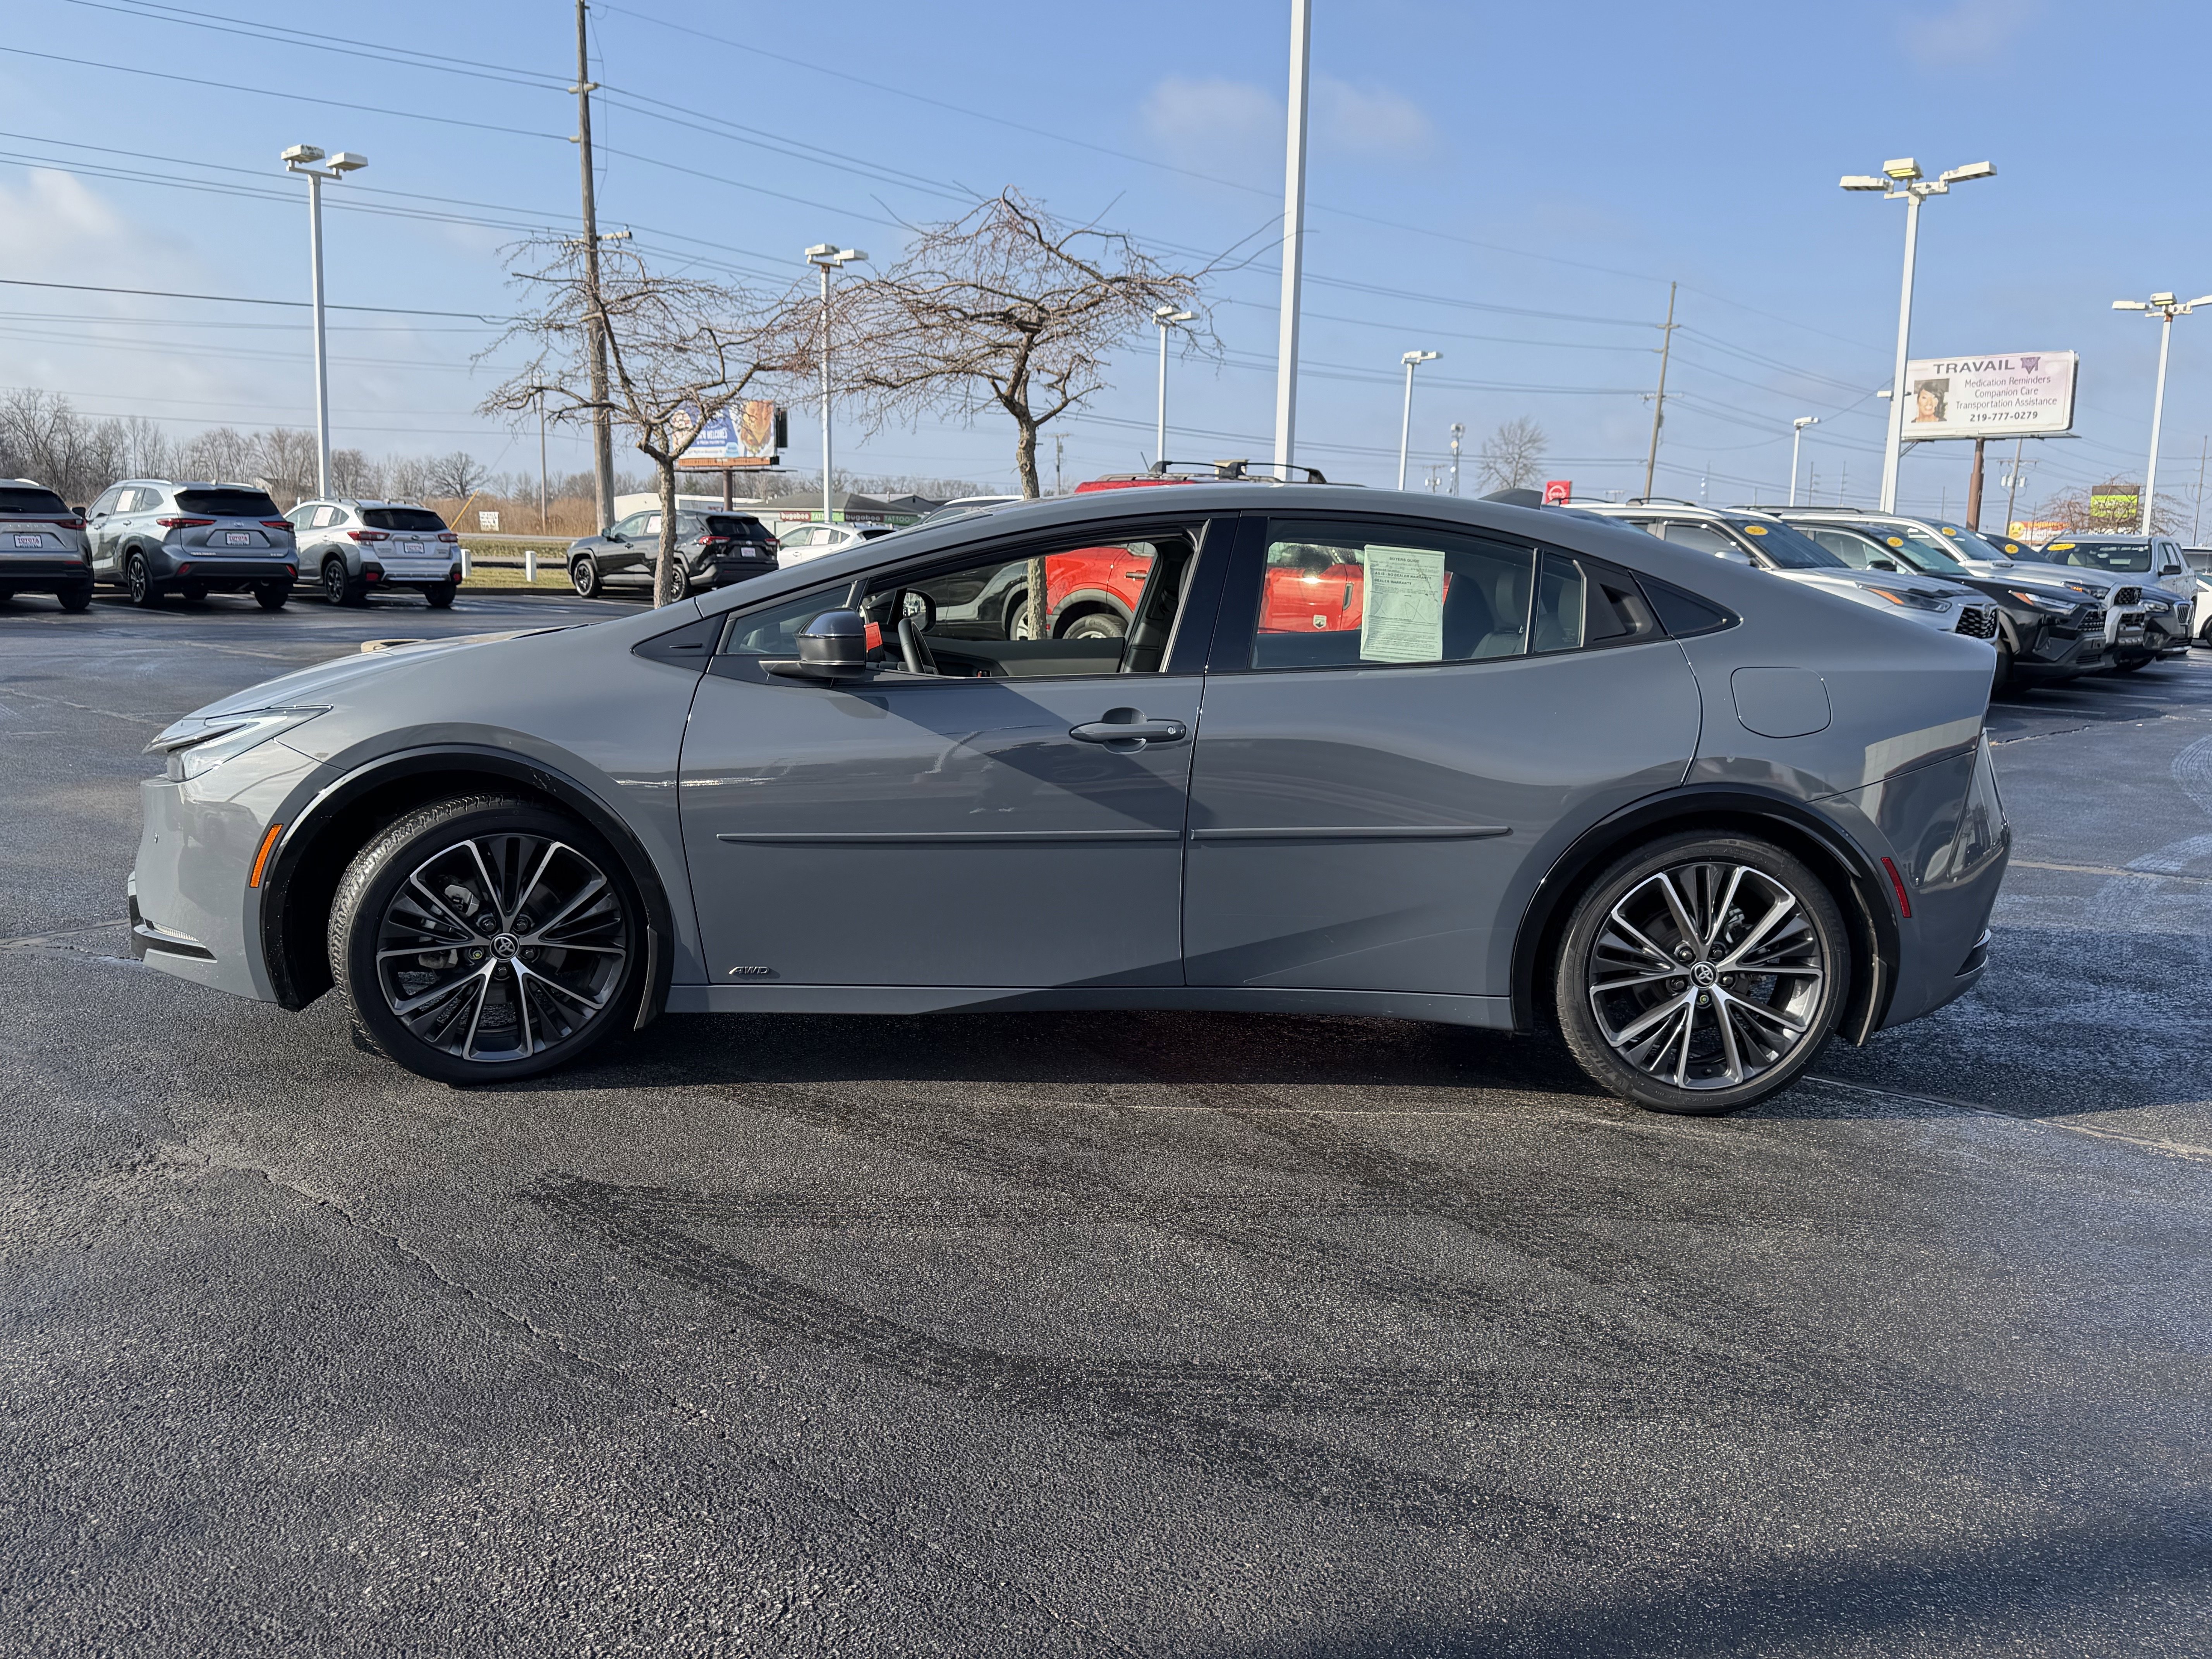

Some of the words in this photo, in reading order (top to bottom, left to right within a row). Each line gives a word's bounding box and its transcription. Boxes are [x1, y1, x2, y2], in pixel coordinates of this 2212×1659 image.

[1933, 359, 2015, 374] TRAVAIL
[1965, 378, 2006, 388] Medication
[2009, 375, 2051, 385] Reminders
[1975, 388, 2018, 399] Companion
[2020, 386, 2039, 396] Care
[1956, 399, 2013, 410] Transportation
[2015, 396, 2057, 407] Assistance
[1970, 411, 2038, 422] 219-777-0279
[781, 512, 809, 520] bugaboo
[729, 966, 769, 974] AWD
[1576, 1023, 1613, 1074] MICHEL
